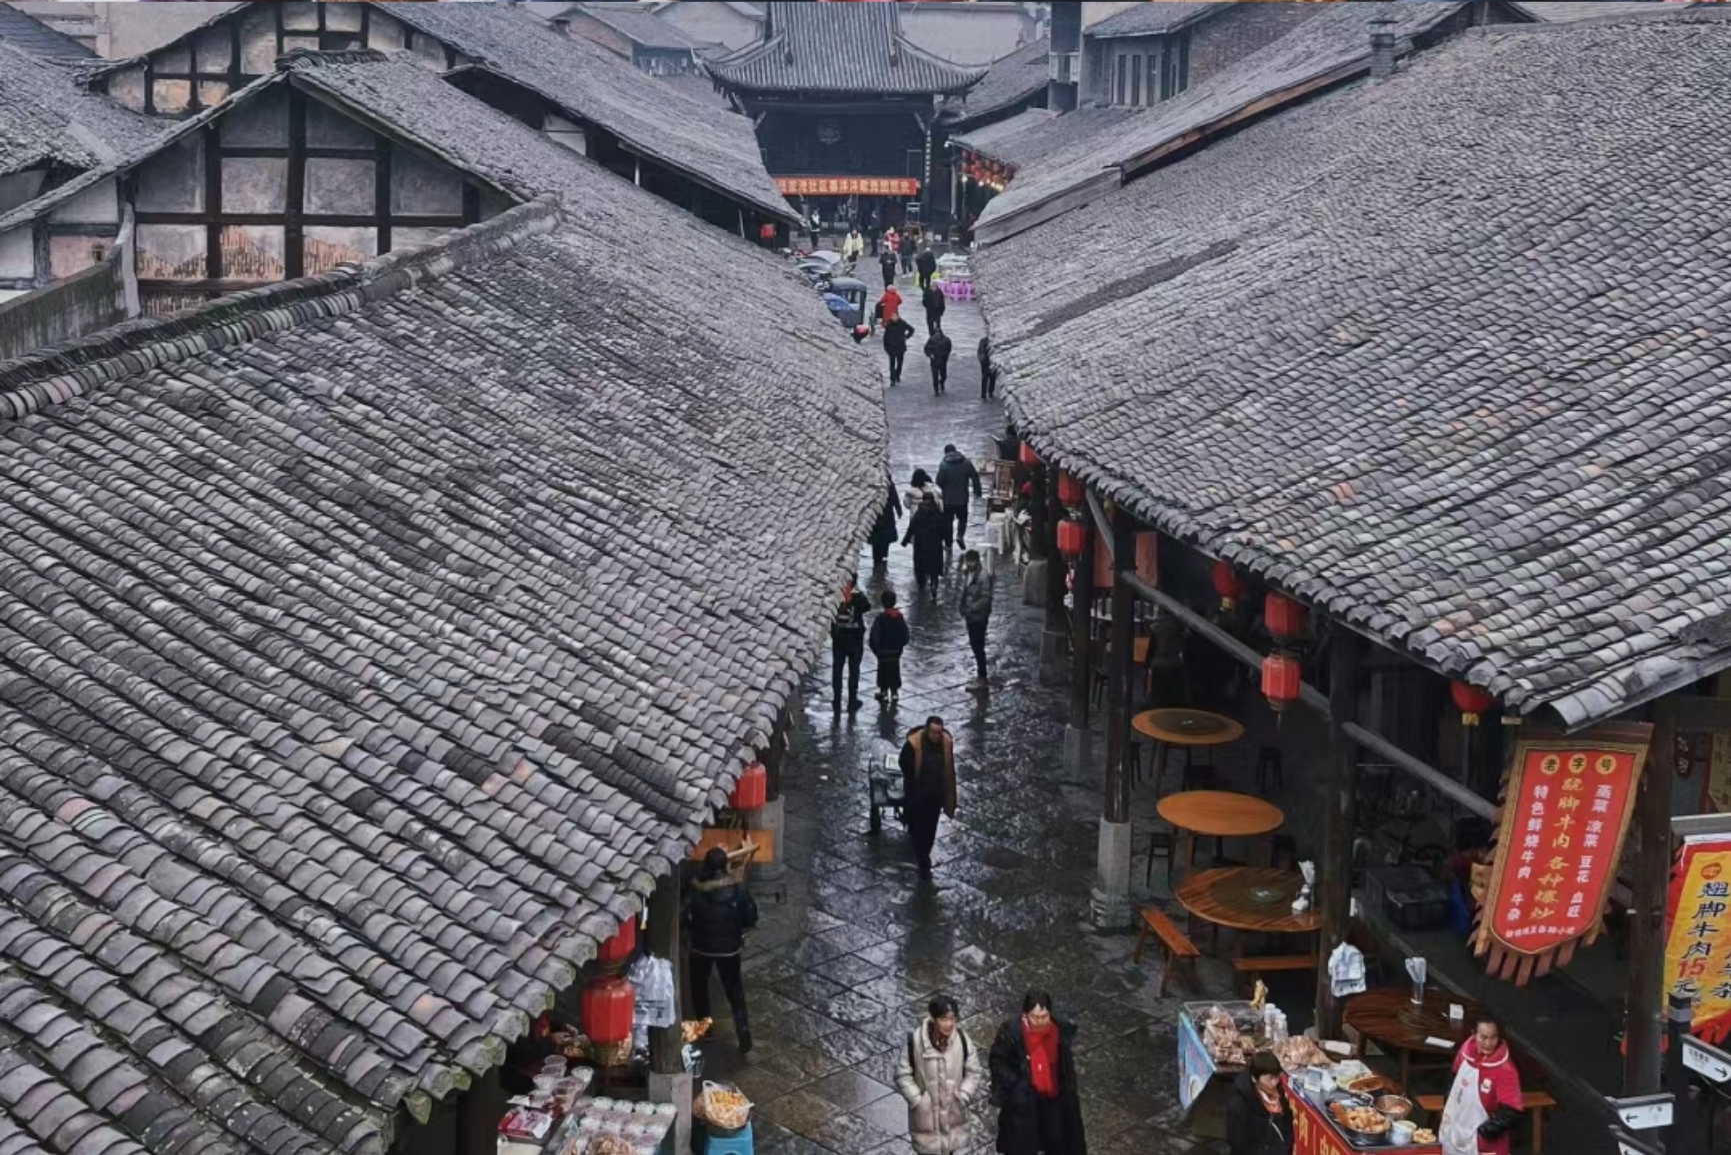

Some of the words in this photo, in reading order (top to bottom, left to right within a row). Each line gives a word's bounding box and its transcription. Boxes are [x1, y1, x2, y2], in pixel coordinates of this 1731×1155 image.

[1543, 756, 1613, 773] 老字号
[1577, 855, 1594, 882] 豆花
